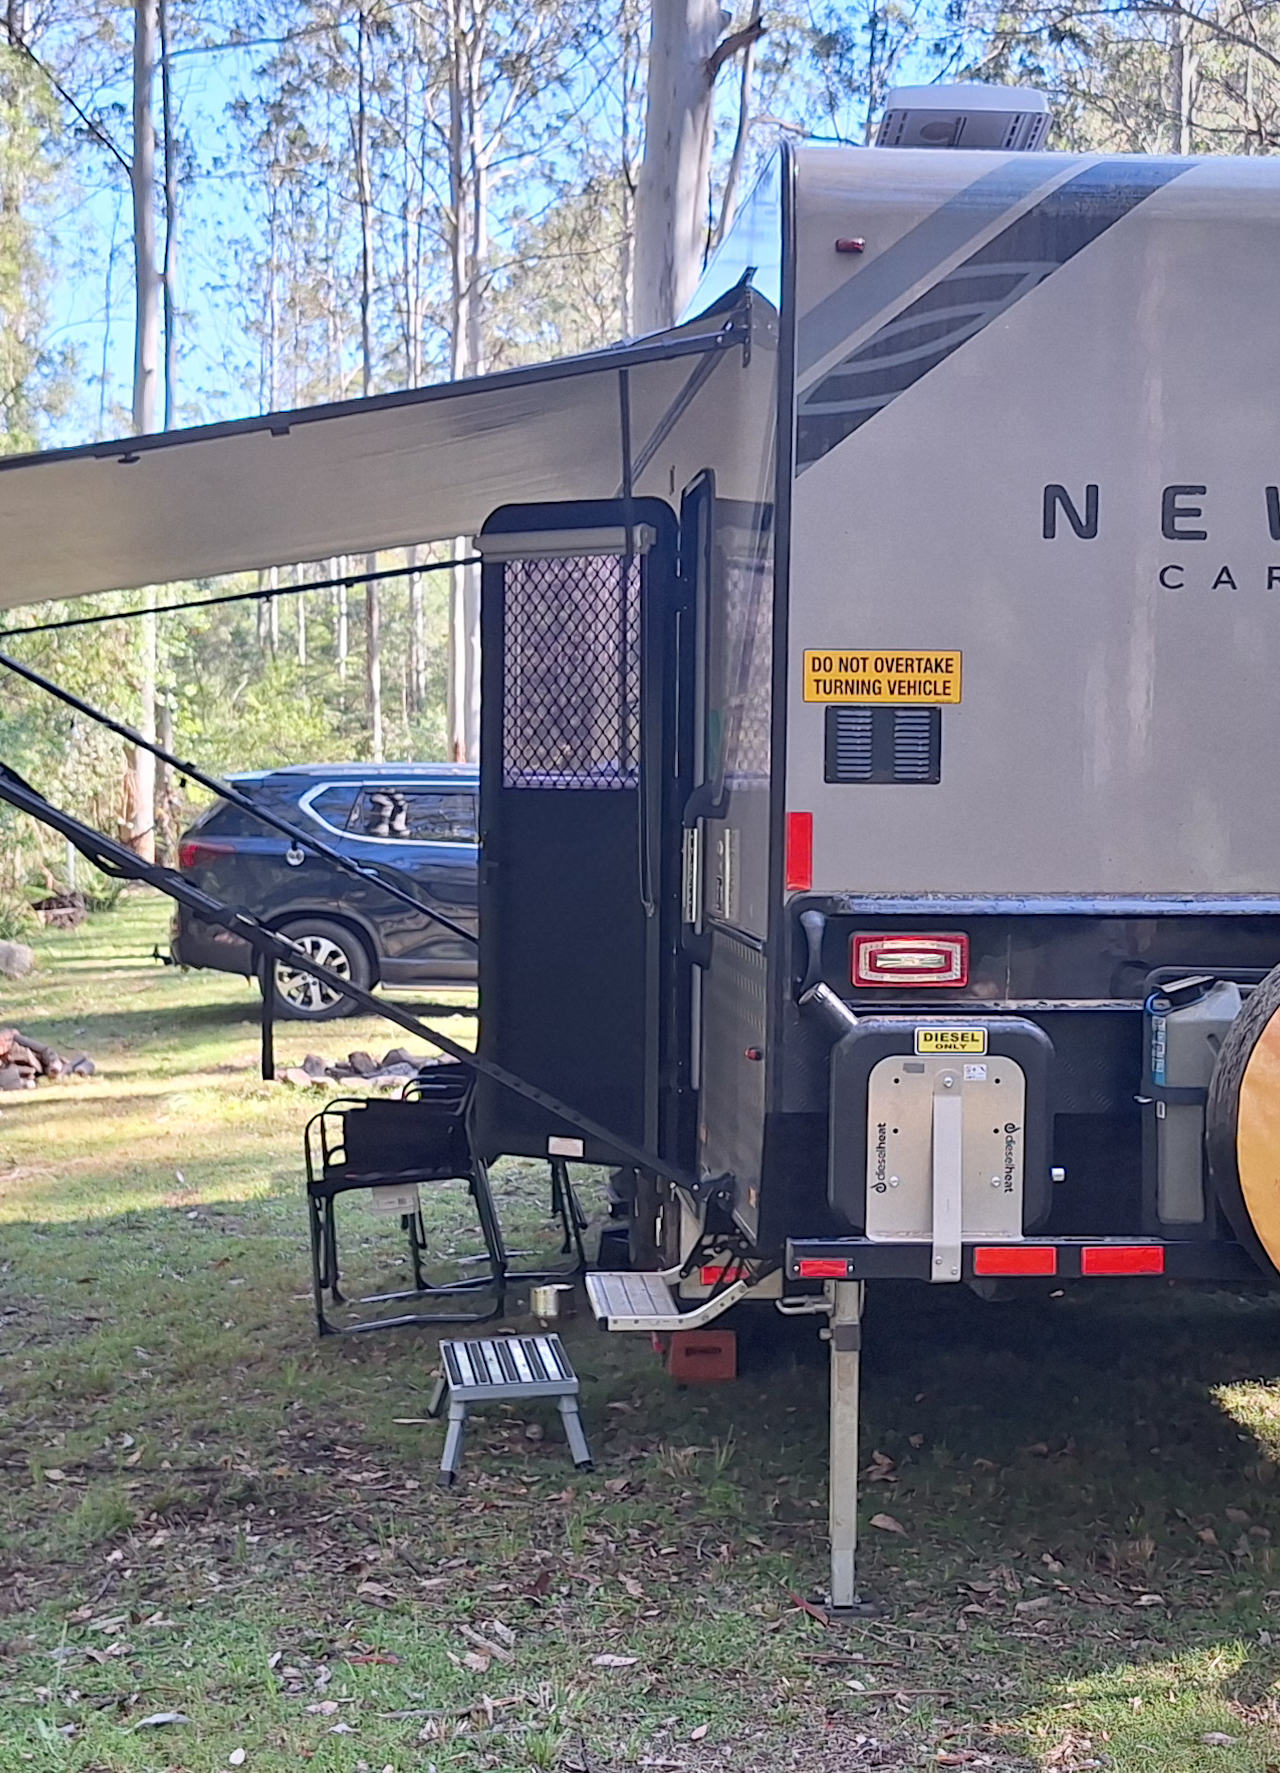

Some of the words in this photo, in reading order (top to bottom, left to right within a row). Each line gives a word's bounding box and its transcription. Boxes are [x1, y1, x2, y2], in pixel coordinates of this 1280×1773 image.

[811, 656, 833, 672] DO
[838, 656, 869, 673] NOT
[874, 657, 954, 674] OVERTAKE
[813, 679, 882, 695] TURNING
[887, 679, 952, 696] VEHICLE
[923, 1032, 980, 1042] DIESEL
[875, 1122, 887, 1181] dieselheat
[1004, 1134, 1016, 1193] dieselheat
